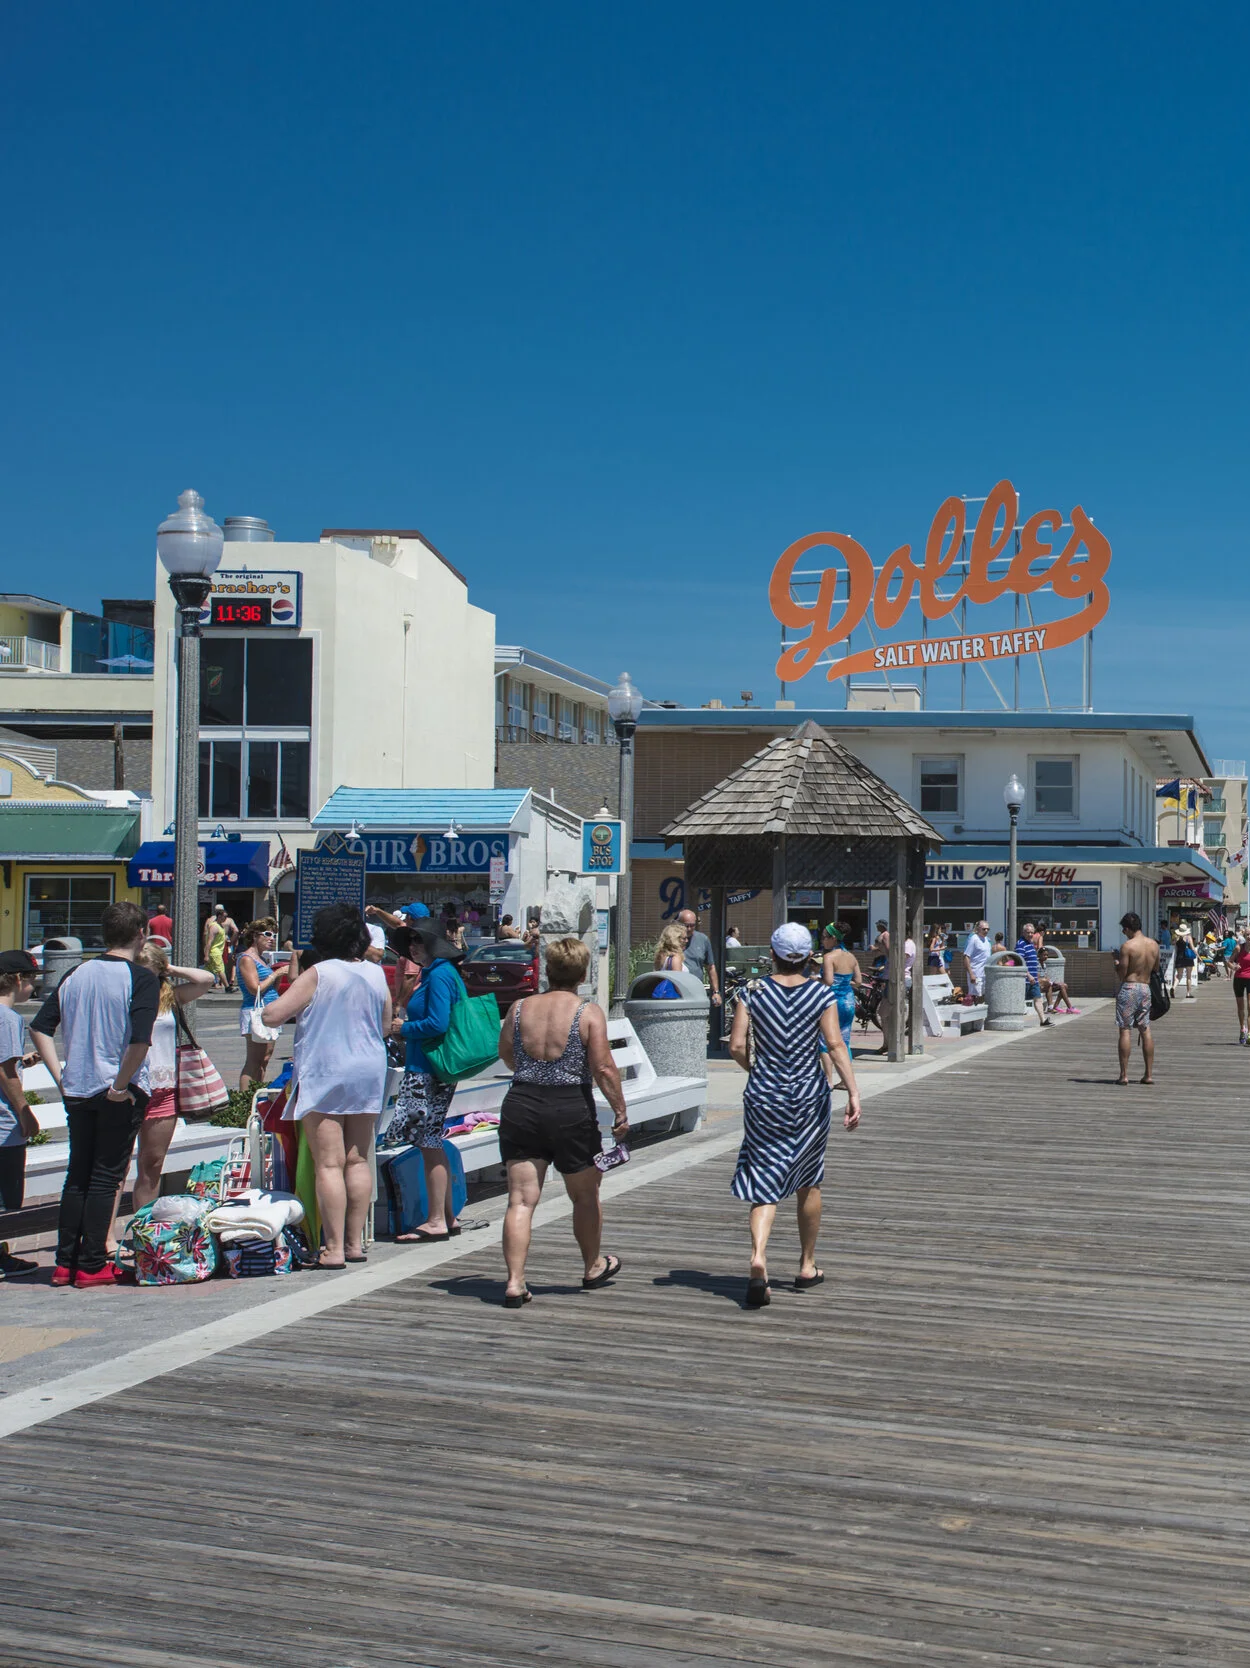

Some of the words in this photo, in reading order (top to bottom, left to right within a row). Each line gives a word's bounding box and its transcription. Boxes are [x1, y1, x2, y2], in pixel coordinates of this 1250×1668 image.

[217, 605, 261, 621] 11:36
[874, 644, 917, 668] SALT
[920, 637, 986, 663] WATER
[988, 628, 1047, 657] TAFFY
[592, 845, 612, 856] BUS
[588, 855, 614, 867] STOP
[1018, 862, 1077, 886] Taffy
[728, 891, 752, 904] TAFFY
[1164, 888, 1197, 897] ARCADE
